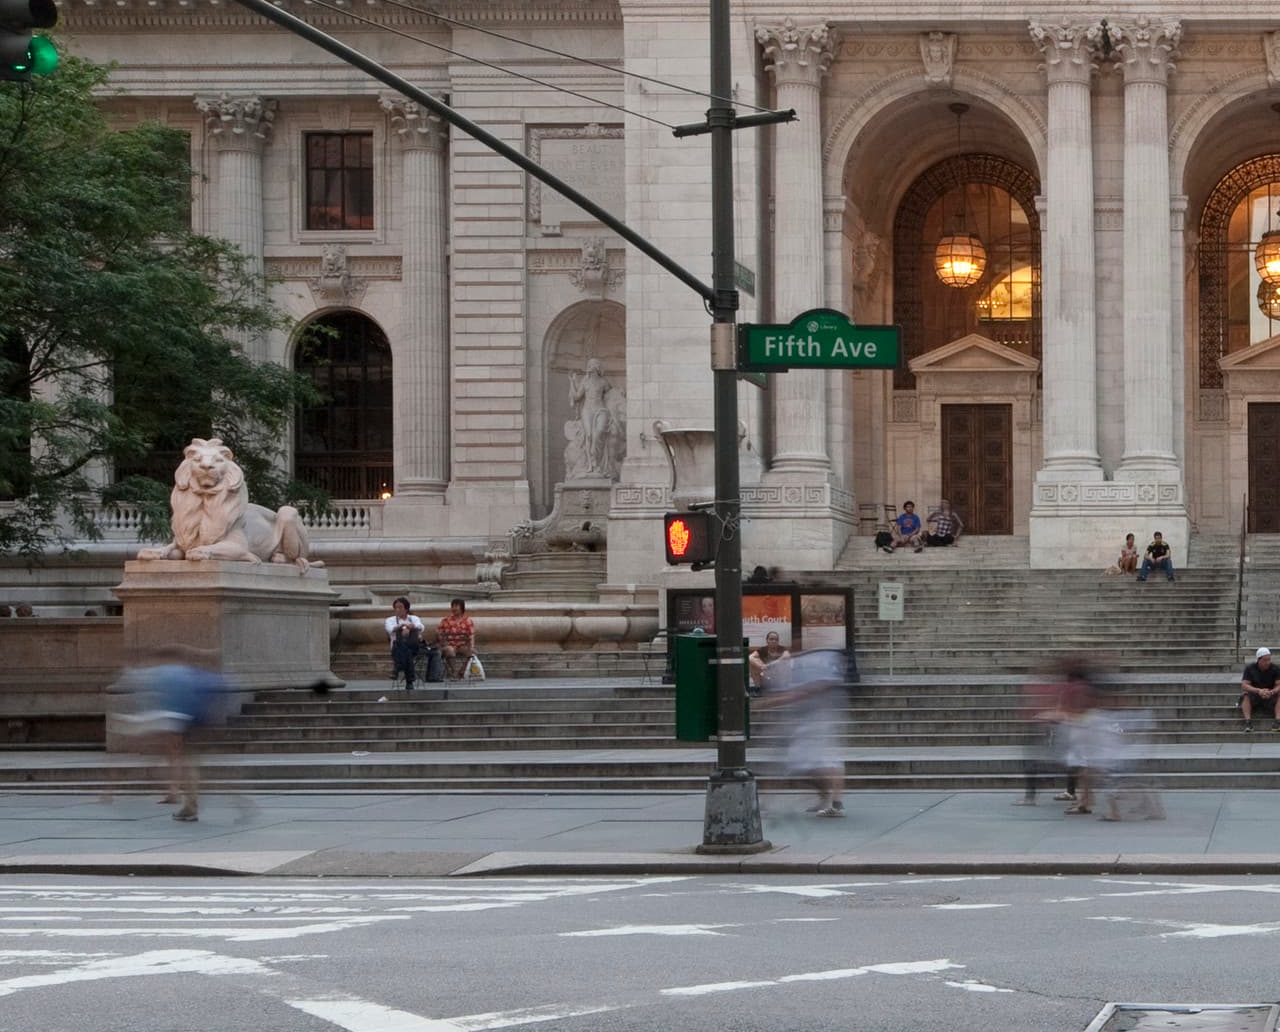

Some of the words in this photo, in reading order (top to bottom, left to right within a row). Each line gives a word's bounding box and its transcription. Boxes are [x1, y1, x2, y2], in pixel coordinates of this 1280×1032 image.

[764, 335, 821, 358] Fifth
[831, 337, 878, 359] Ave
[762, 614, 789, 624] Court
